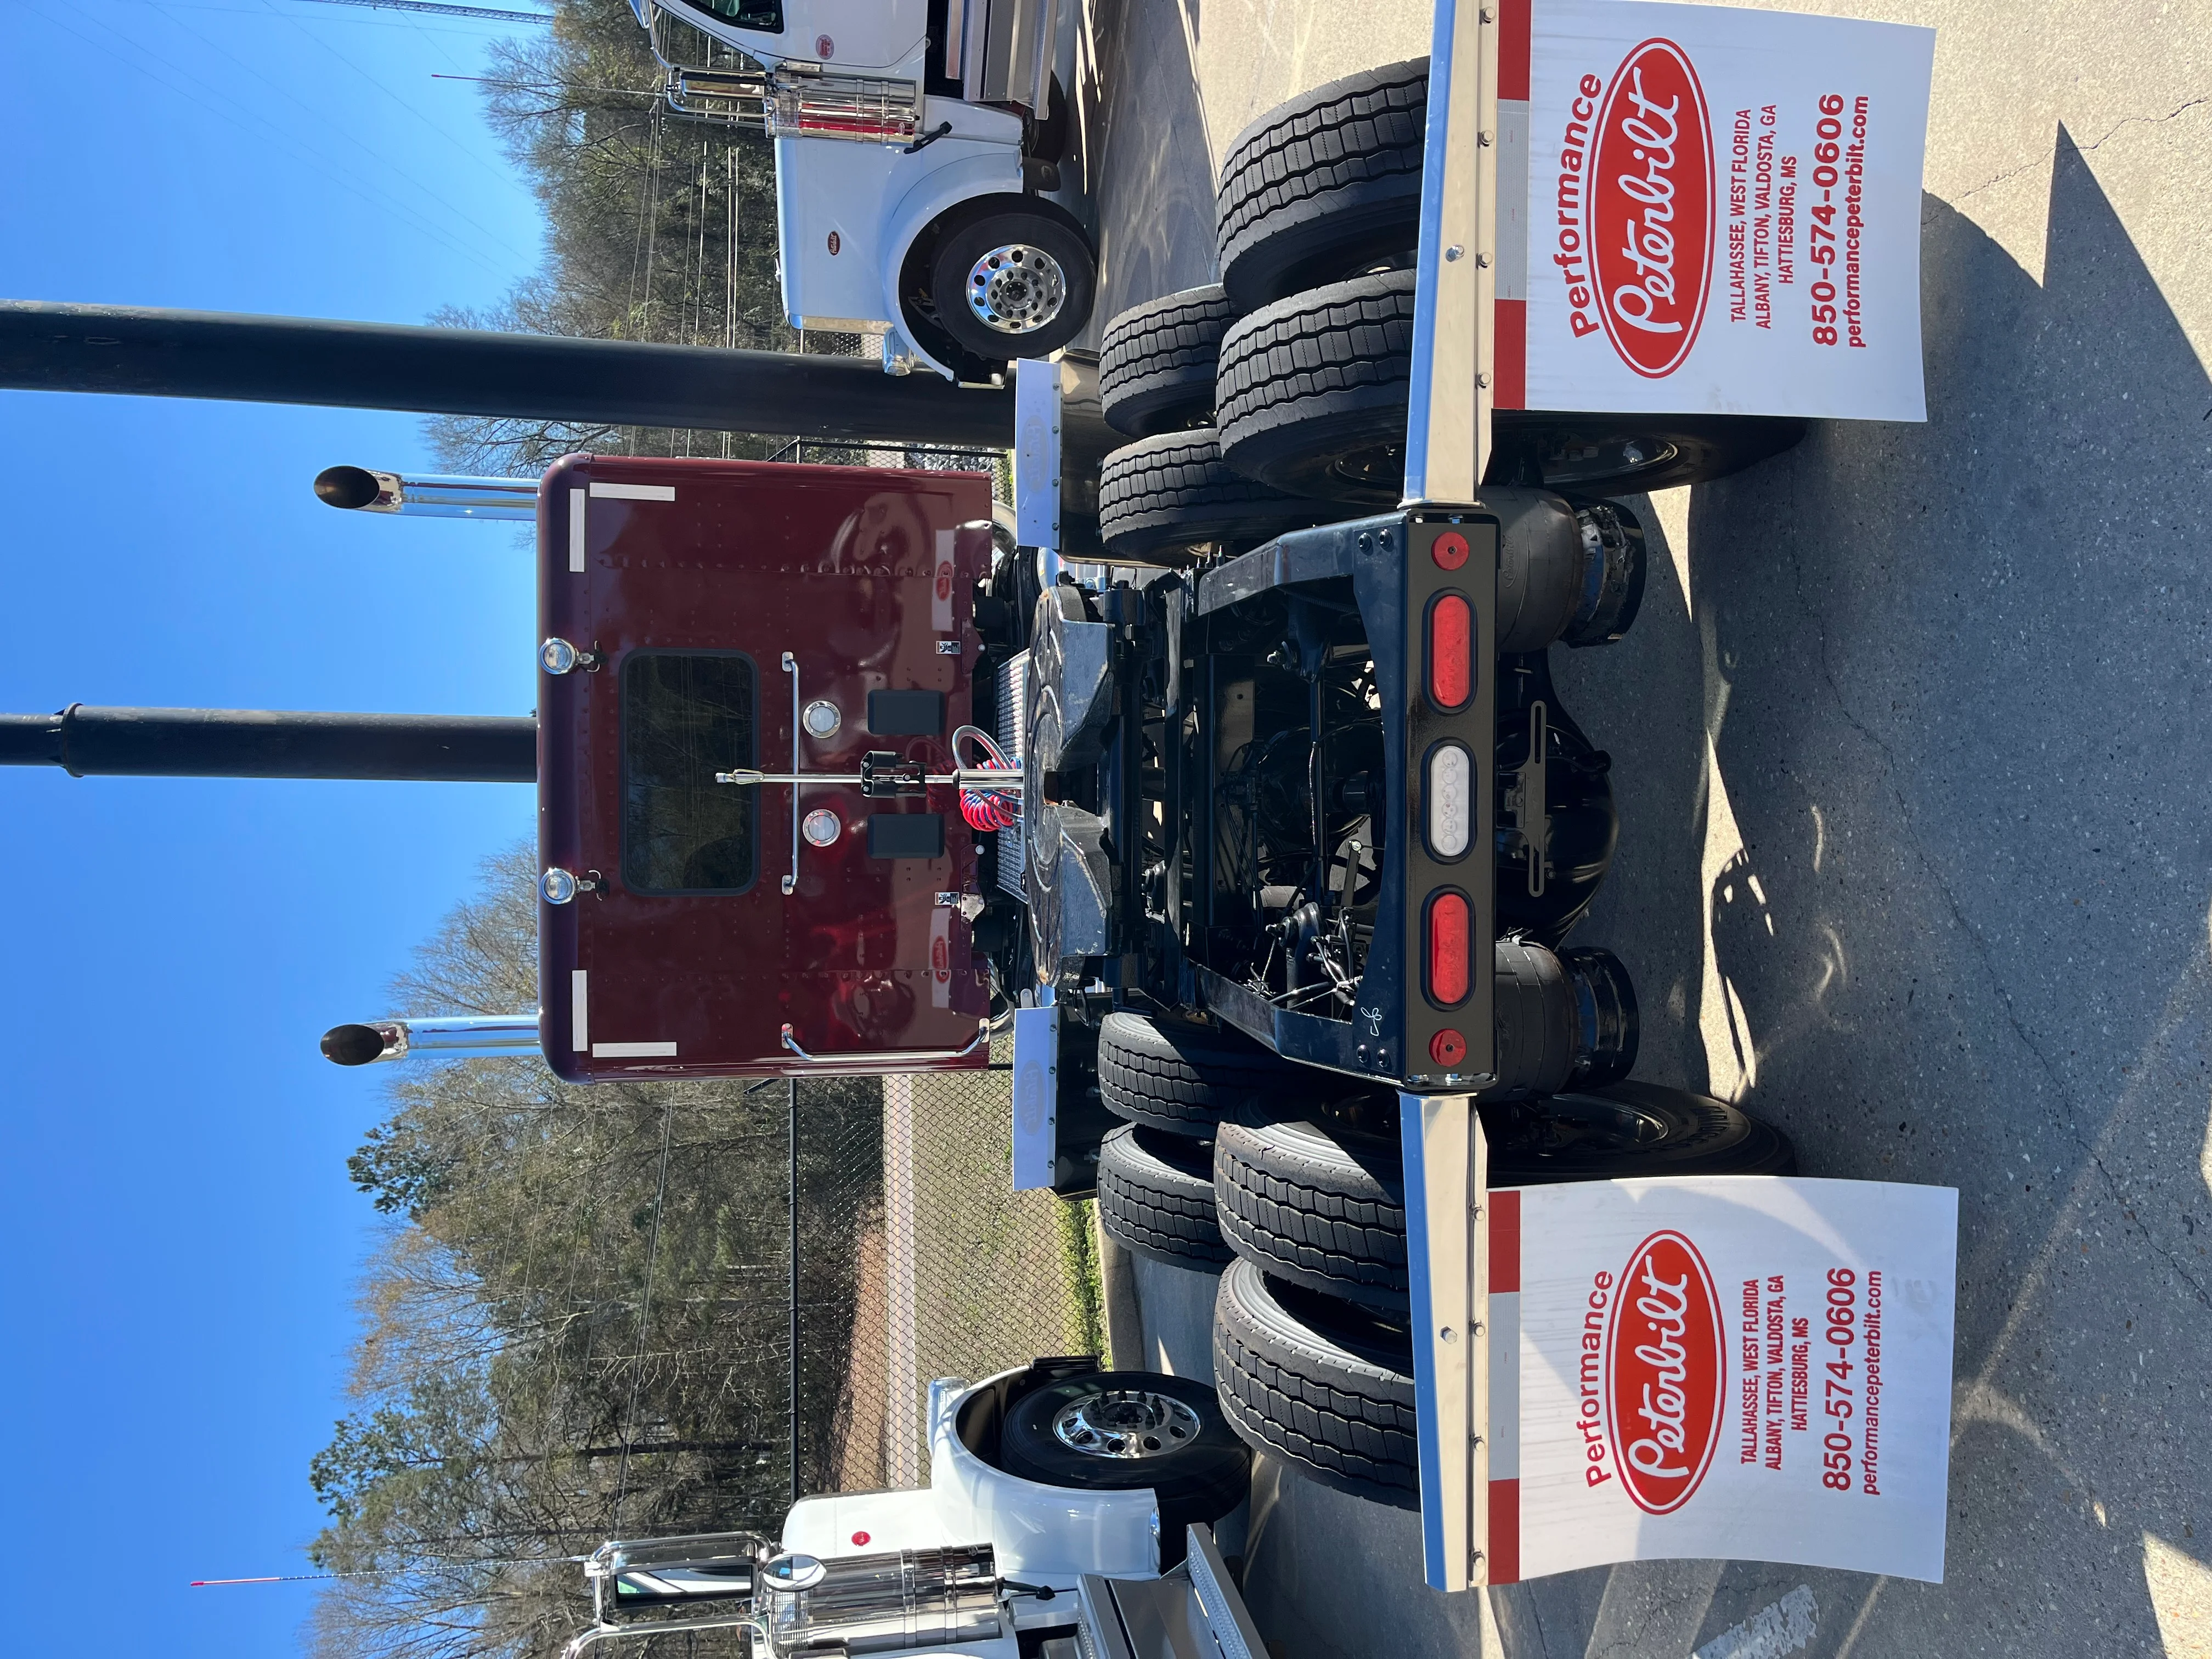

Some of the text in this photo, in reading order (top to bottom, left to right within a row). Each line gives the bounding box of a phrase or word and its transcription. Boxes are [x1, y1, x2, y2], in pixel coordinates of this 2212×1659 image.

[1553, 73, 1602, 338] Performance
[1612, 66, 1683, 332] Peterbilt
[1729, 109, 1751, 322] TALLAHASSEE, WEST FLORIDA
[1753, 105, 1776, 330] ALBANY, TIFTON, VALDOSTA, GA
[1778, 156, 1797, 284] HATTIESBURG, MS
[1810, 94, 1844, 347] 850-574-0606
[1843, 96, 1869, 348] performancepeterbilt.com
[1576, 1270, 1613, 1488] Performance
[1628, 1254, 1690, 1477] Peterbilt
[1740, 1279, 1760, 1465] TALLAHASSEE, WEST FLORIDA
[1765, 1275, 1786, 1471] ALBANY, TIFTON, VALDOSTA, GA
[1790, 1317, 1810, 1431] HATTIESBURG, MS
[1822, 1268, 1856, 1492] 850-574-0606
[1860, 1271, 1883, 1496] performancepeterbilt.com
